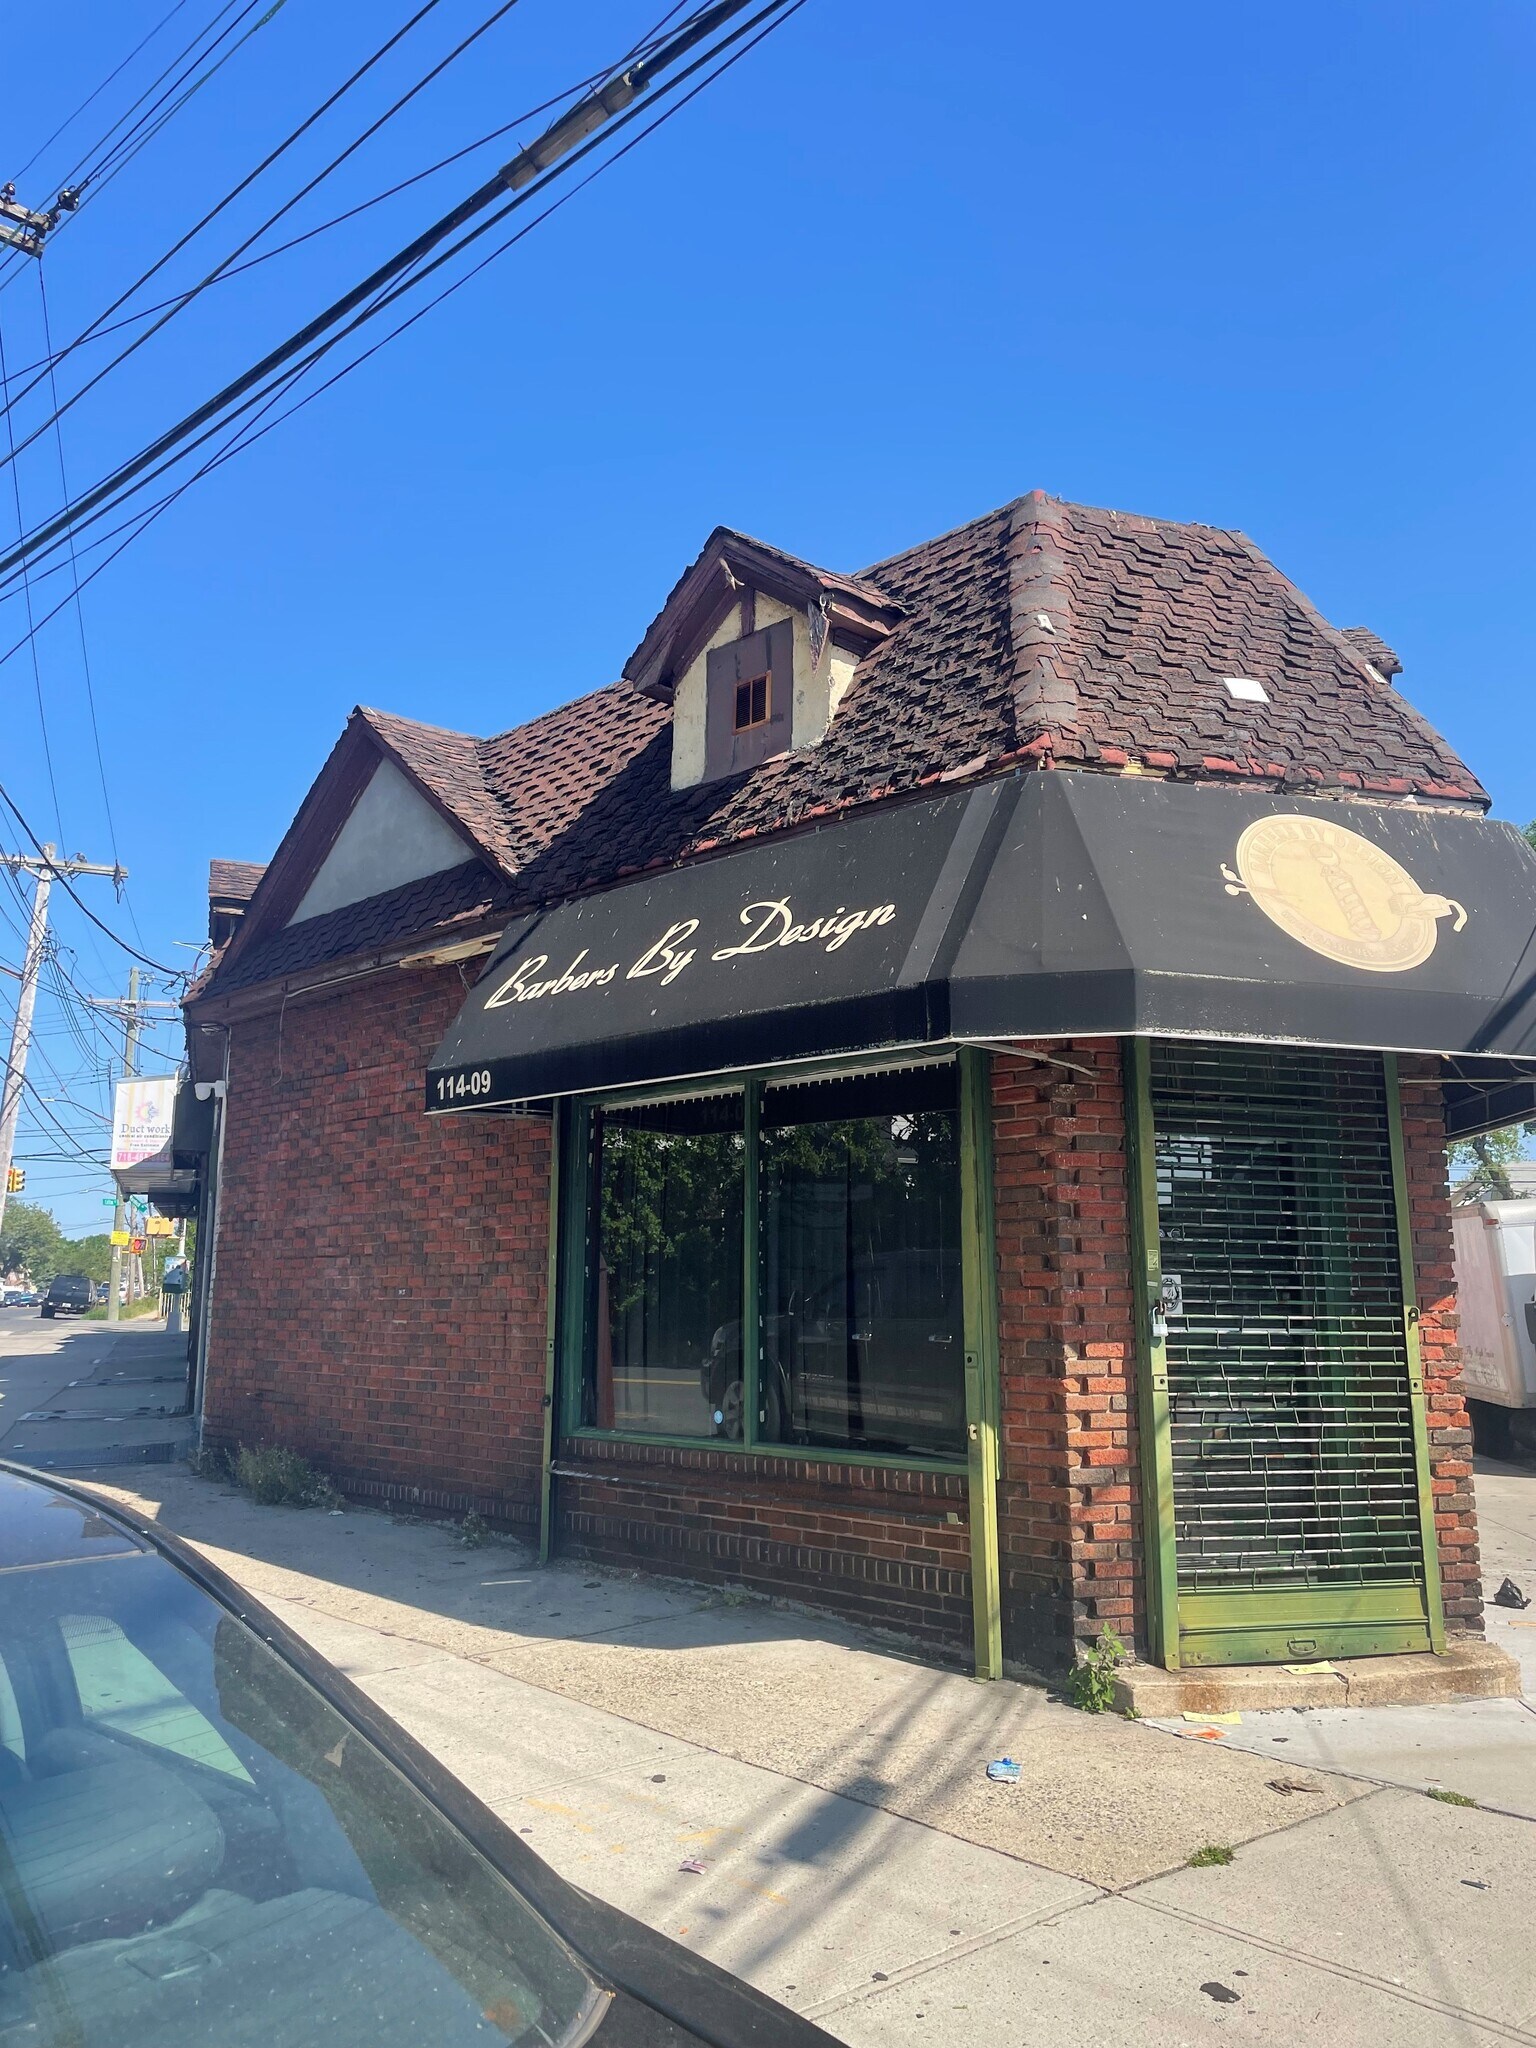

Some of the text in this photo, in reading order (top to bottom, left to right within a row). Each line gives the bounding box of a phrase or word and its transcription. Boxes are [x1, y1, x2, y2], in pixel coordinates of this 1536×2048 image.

[483, 895, 896, 1010] Barbers By Design
[435, 1069, 492, 1101] 114-09
[121, 1123, 171, 1134] Duct work
